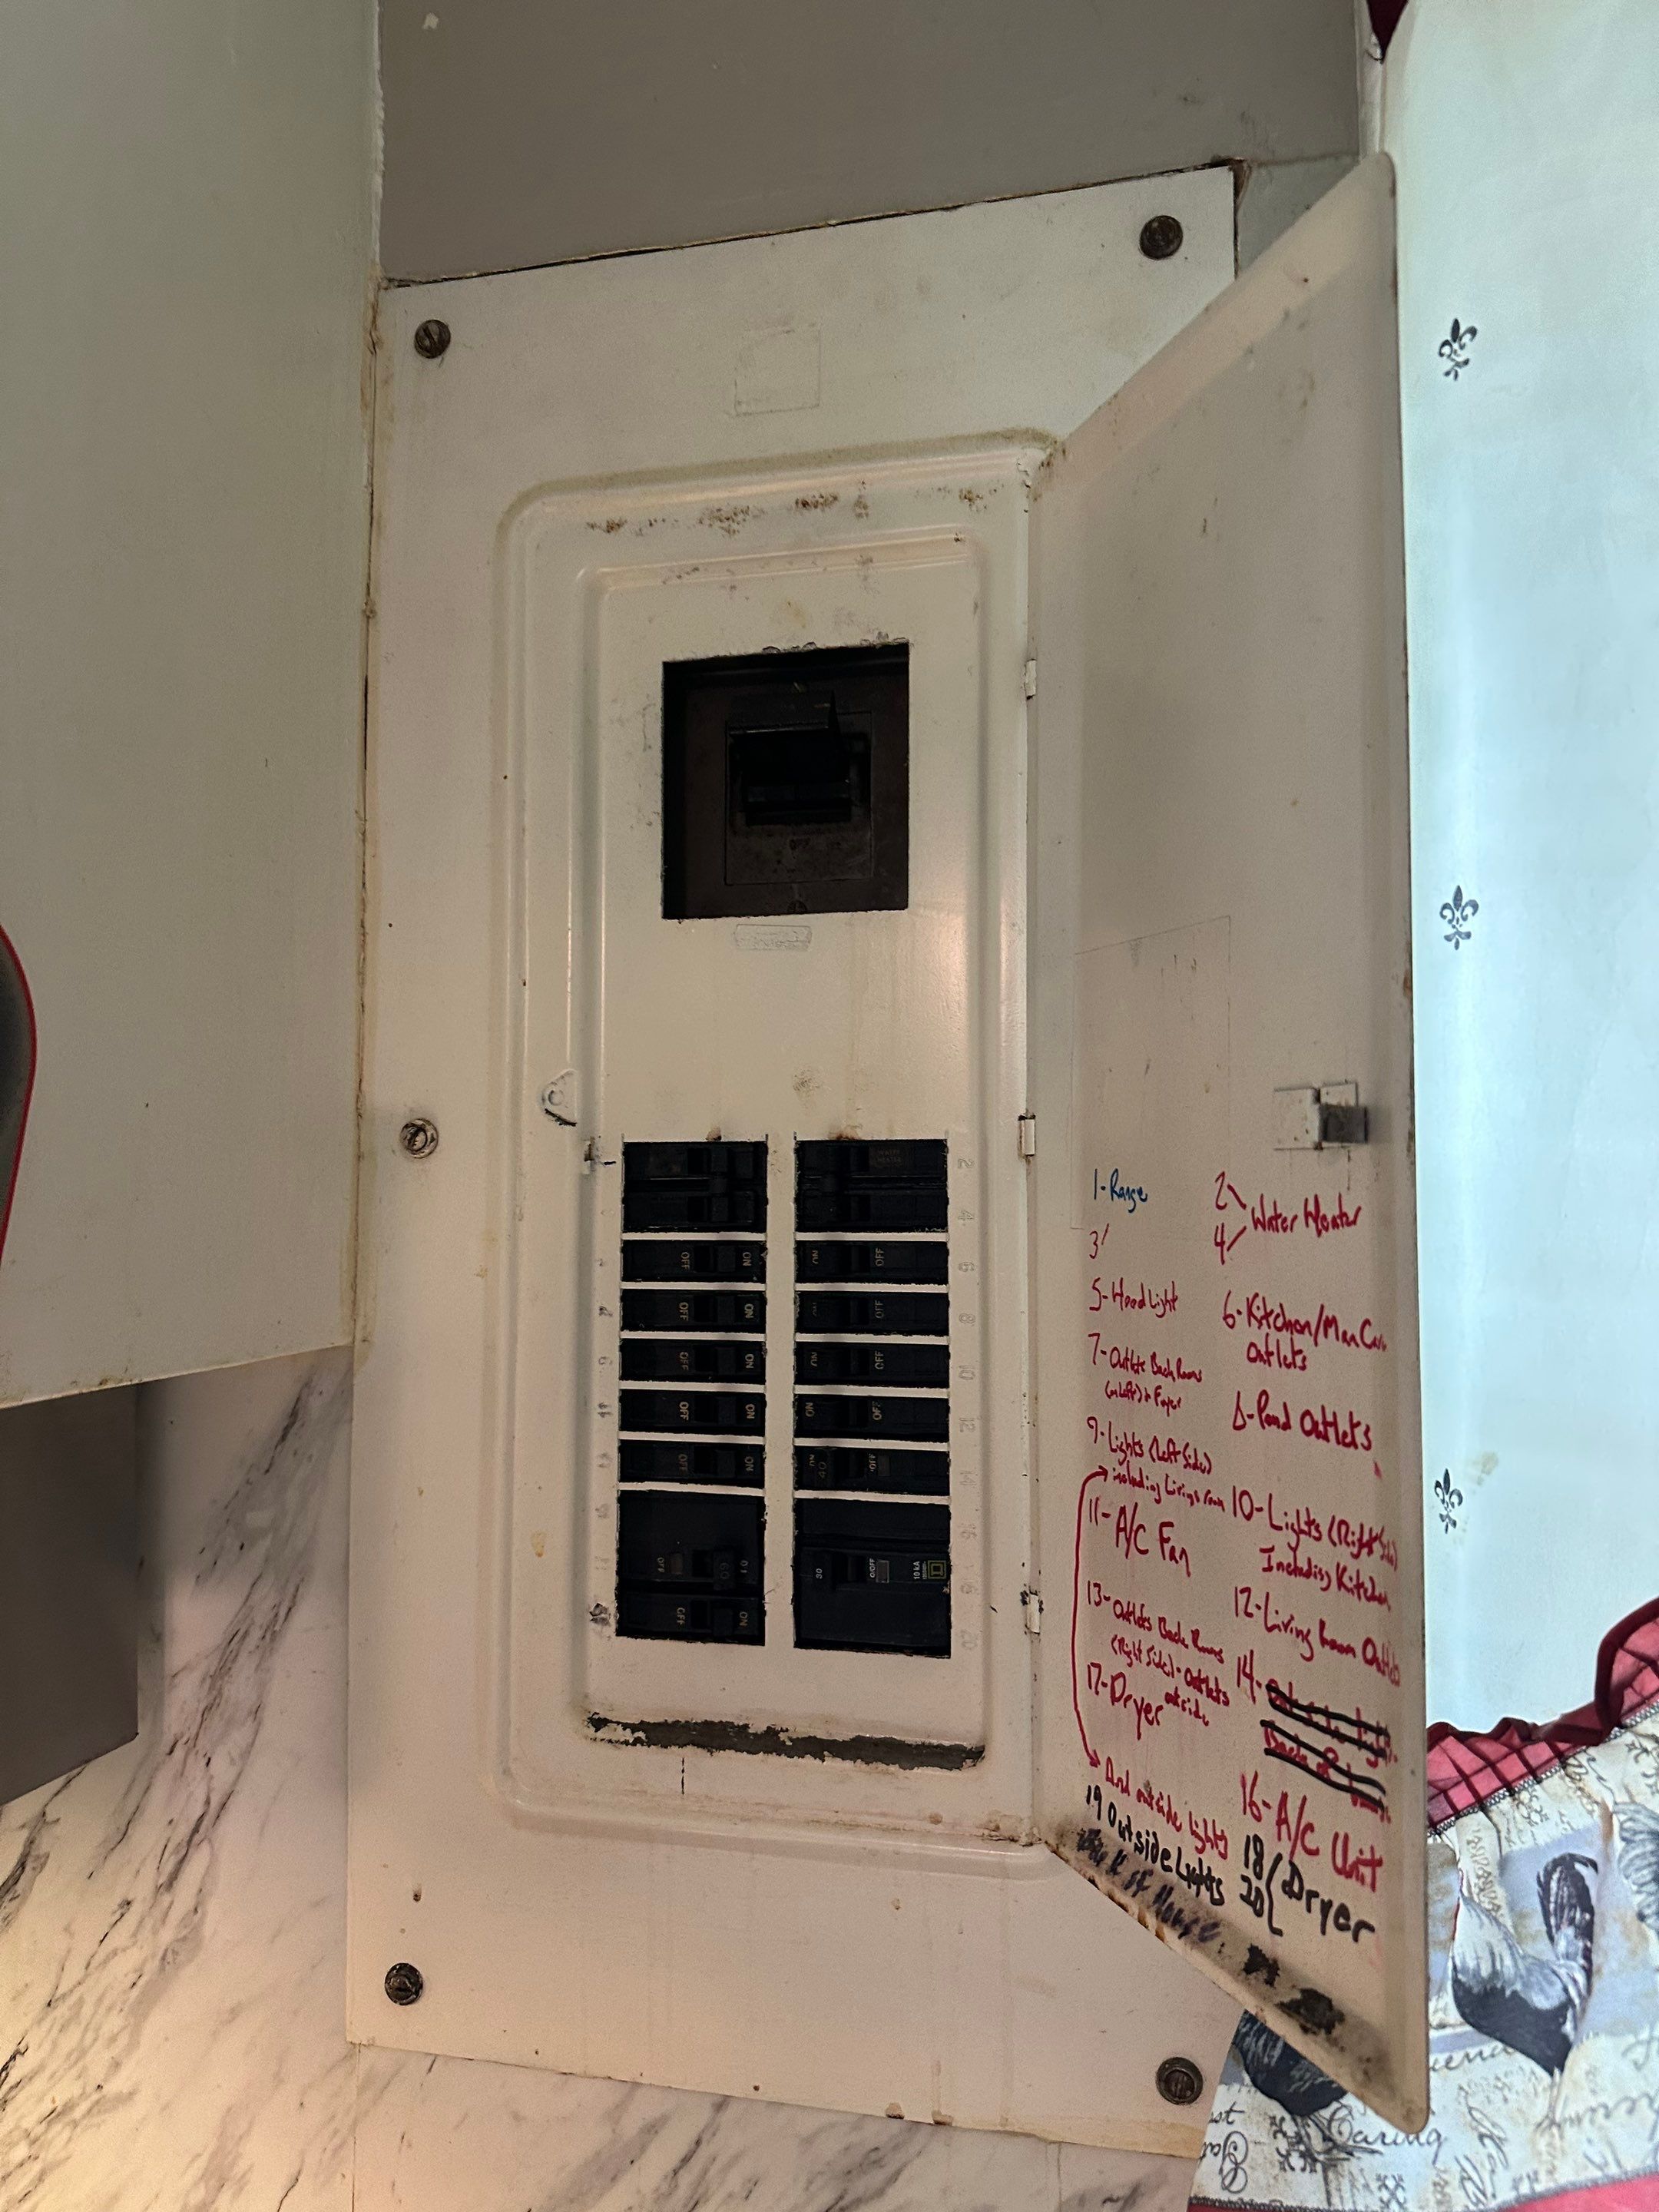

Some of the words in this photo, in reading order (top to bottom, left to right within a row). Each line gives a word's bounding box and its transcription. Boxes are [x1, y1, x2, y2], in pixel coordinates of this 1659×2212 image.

[1251, 1193, 1299, 1233] Water
[680, 1251, 690, 1271] OFF
[742, 1251, 752, 1267] ON
[874, 1247, 883, 1267] OFF
[679, 1302, 689, 1322] OFF
[743, 1303, 754, 1320] ON
[874, 1300, 883, 1319] OFF
[679, 1351, 689, 1371] OFF
[745, 1353, 755, 1369] ON
[874, 1349, 883, 1370] OFF
[1247, 1332, 1307, 1372] Outlets
[679, 1401, 689, 1422] OFF
[745, 1403, 756, 1420] ON
[804, 1402, 814, 1418] ON
[1300, 1404, 1372, 1451] Outlets
[744, 1455, 755, 1472] ON
[1158, 1520, 1192, 1578] Fan
[815, 1568, 823, 1579] 30
[912, 1571, 921, 1580] 10
[739, 1611, 750, 1628] ON
[1086, 1784, 1102, 1821] 19
[1243, 1833, 1265, 1881] 18
[1331, 1830, 1384, 1893] Unit
[1281, 1859, 1376, 1943] Dryer
